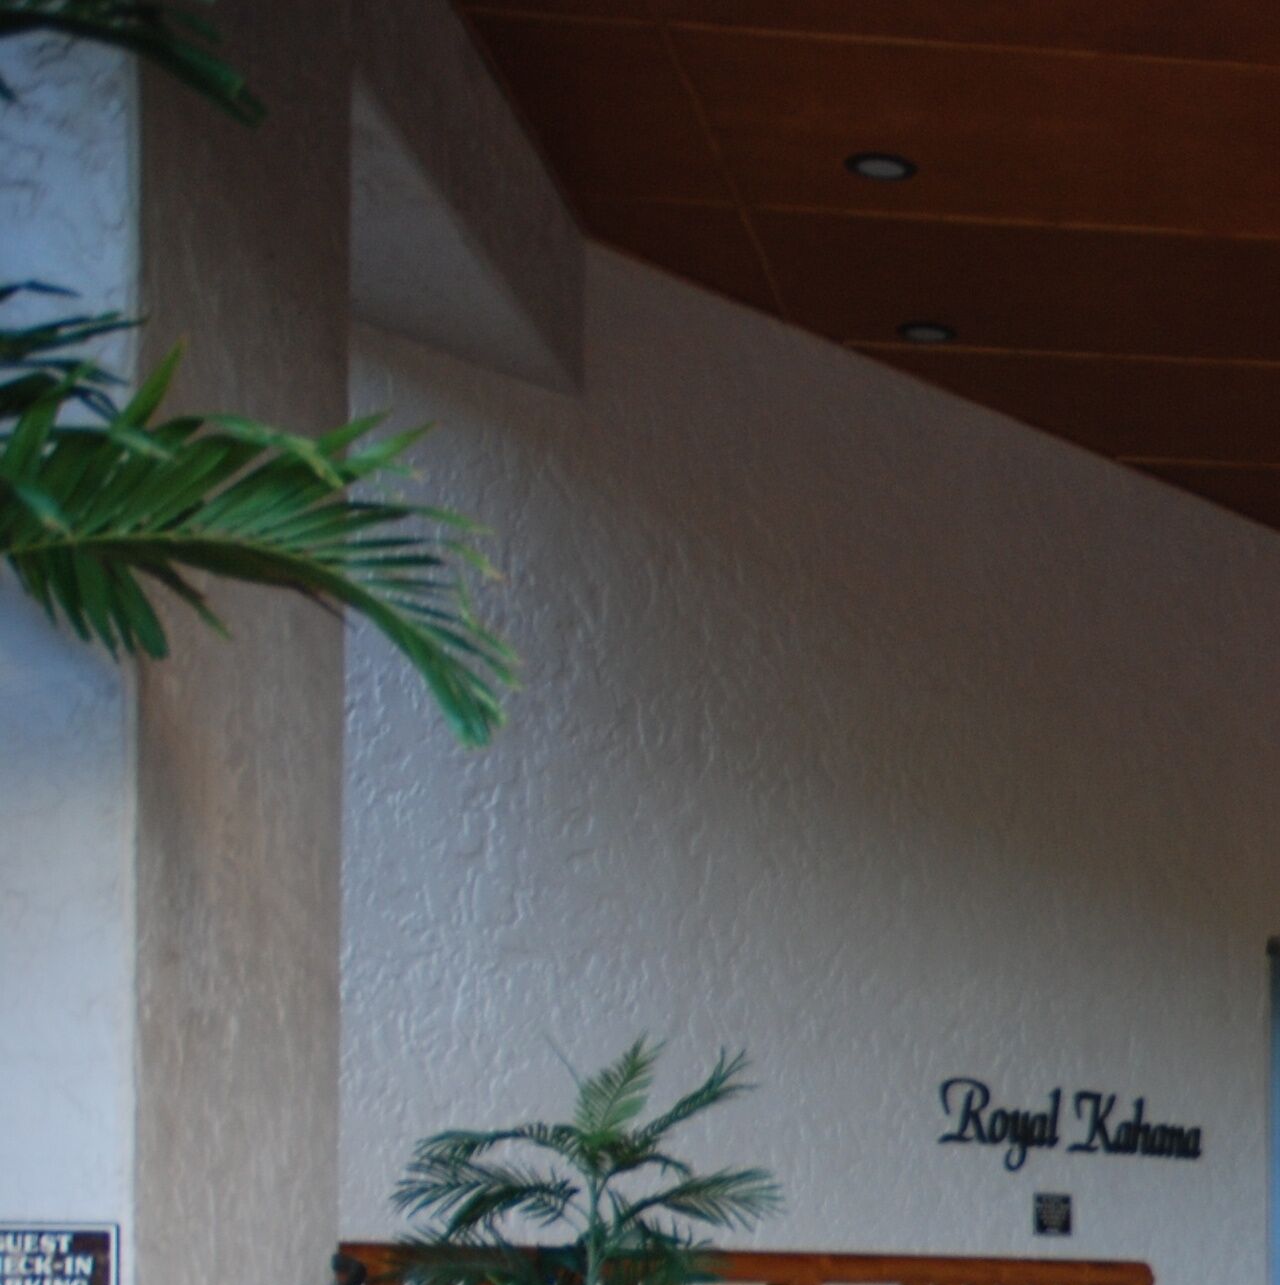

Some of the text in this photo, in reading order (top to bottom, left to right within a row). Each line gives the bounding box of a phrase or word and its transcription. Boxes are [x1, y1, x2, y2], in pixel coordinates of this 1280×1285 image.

[938, 1077, 1202, 1172] Royal Kahana
[0, 1232, 72, 1251] UEST
[0, 1255, 94, 1276] ECK-IN
